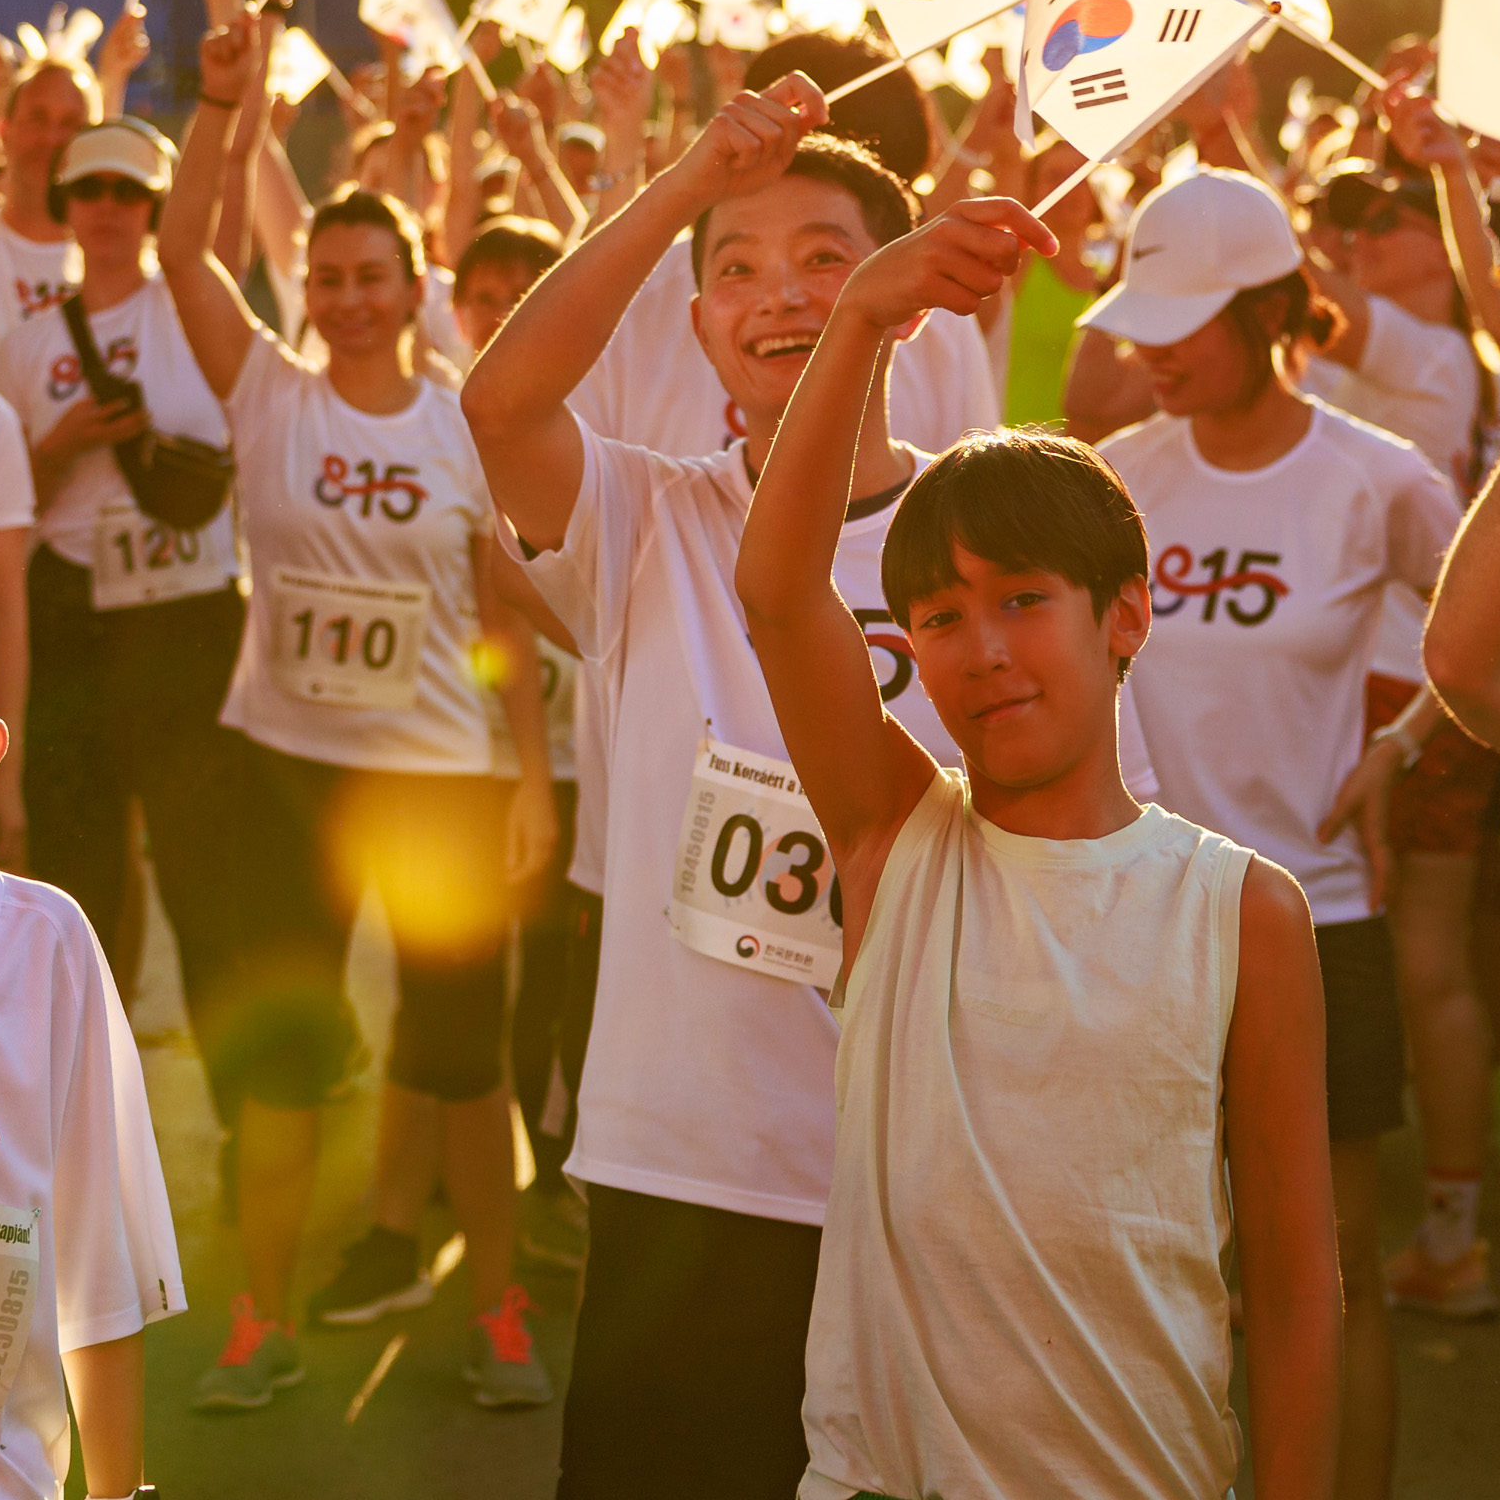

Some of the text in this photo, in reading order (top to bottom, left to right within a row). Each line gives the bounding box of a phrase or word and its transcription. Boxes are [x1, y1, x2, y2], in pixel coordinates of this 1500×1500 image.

[314, 454, 429, 523] 815
[114, 523, 200, 573] 120
[1153, 544, 1290, 627] 815
[292, 606, 397, 671] 110
[711, 813, 844, 930] 03
